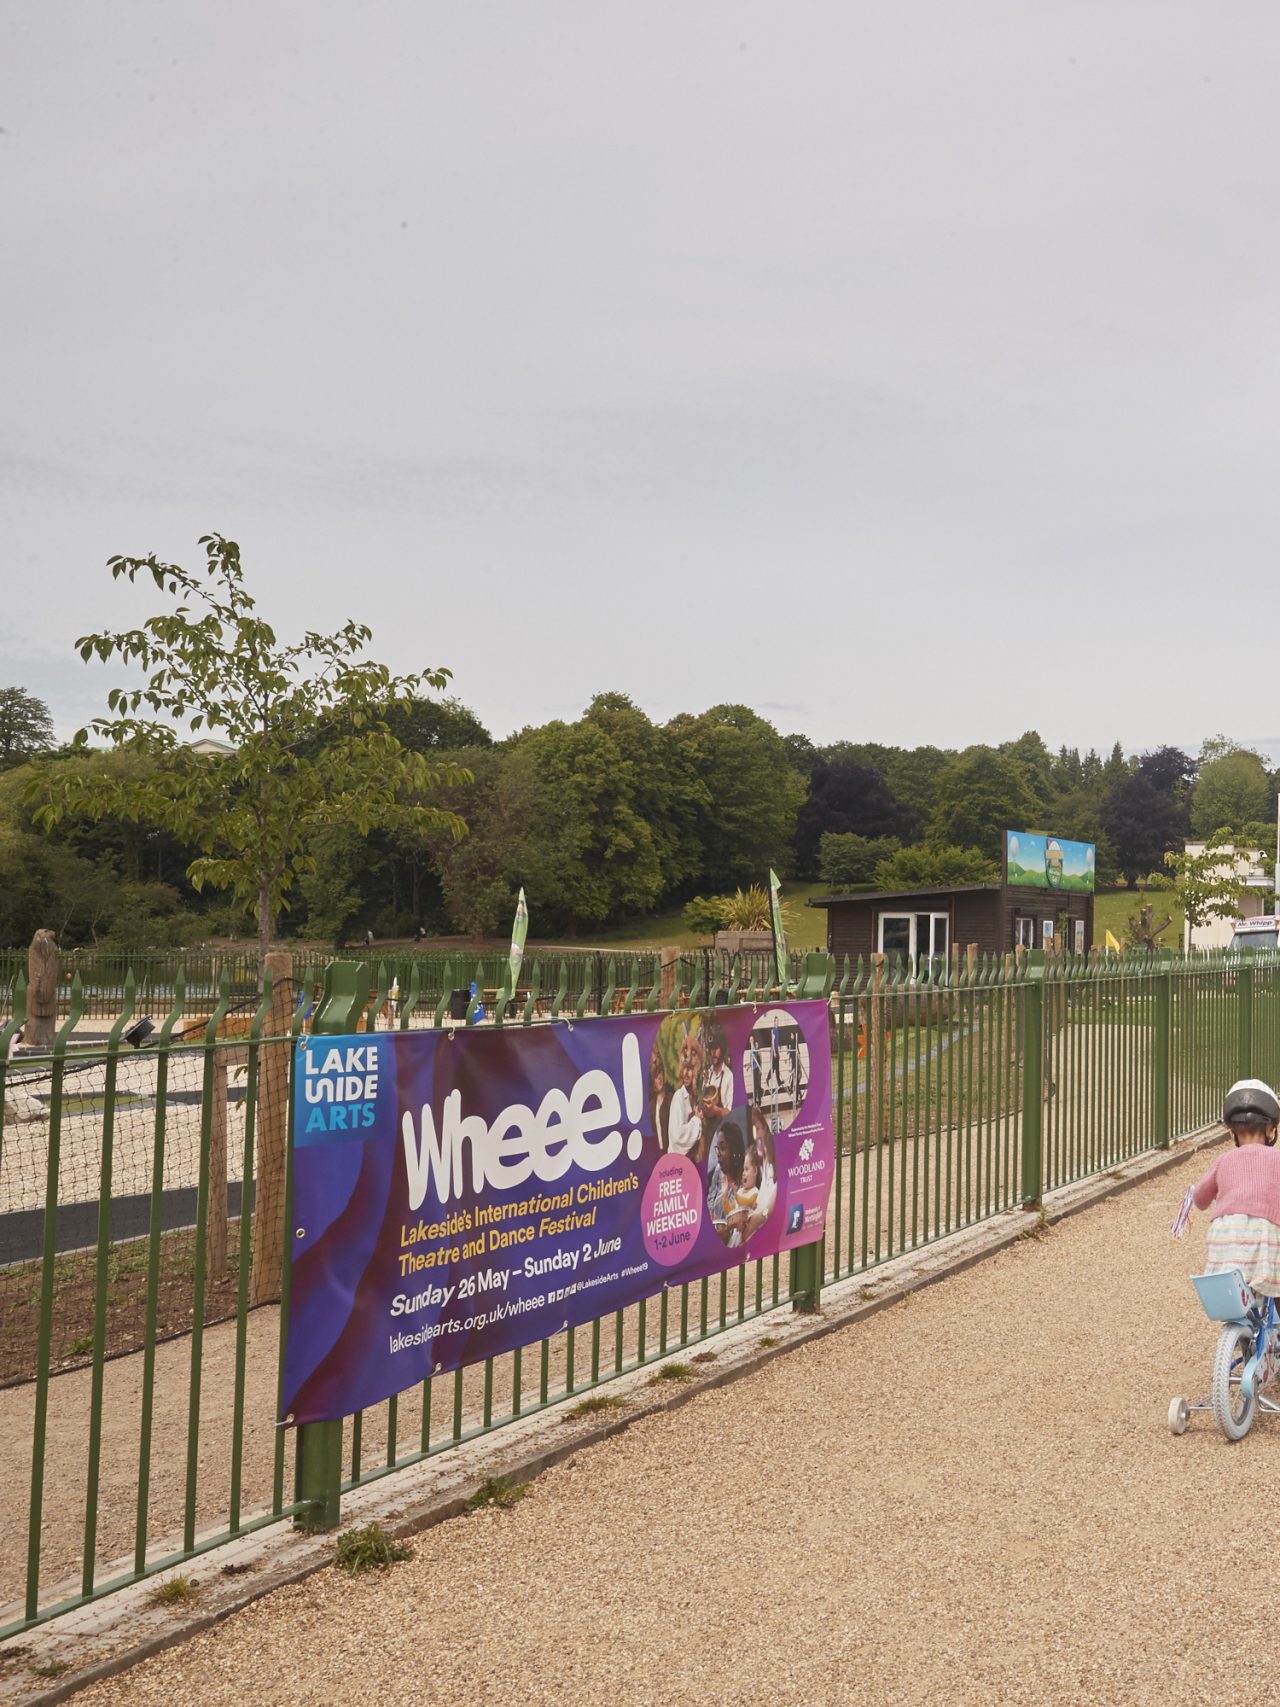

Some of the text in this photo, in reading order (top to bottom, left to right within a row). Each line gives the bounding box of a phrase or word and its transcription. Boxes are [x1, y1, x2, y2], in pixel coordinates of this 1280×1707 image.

[305, 1046, 378, 1074] LAKE
[305, 1103, 376, 1133] ARTS
[402, 1032, 643, 1211] Wheee!
[788, 1160, 825, 1177] WOODLAND
[800, 1174, 813, 1184] TRUST
[659, 1178, 682, 1198] FREE
[400, 1172, 639, 1247] Lakeside's International Children's
[653, 1193, 690, 1218] FAMILY
[646, 1209, 698, 1237] WEEKEND
[398, 1206, 597, 1277] Theatre and Dance Festival
[654, 1231, 691, 1250] 1-2 June
[390, 1283, 456, 1316] Sunday
[458, 1276, 476, 1300] 26
[477, 1268, 510, 1293] May
[524, 1249, 580, 1278] Sunday
[582, 1244, 592, 1262] 2
[594, 1235, 622, 1259] June
[577, 1262, 648, 1290] @LakesideArts #Wheee19
[389, 1293, 545, 1354] lakesidearts.org.uk/wheee
